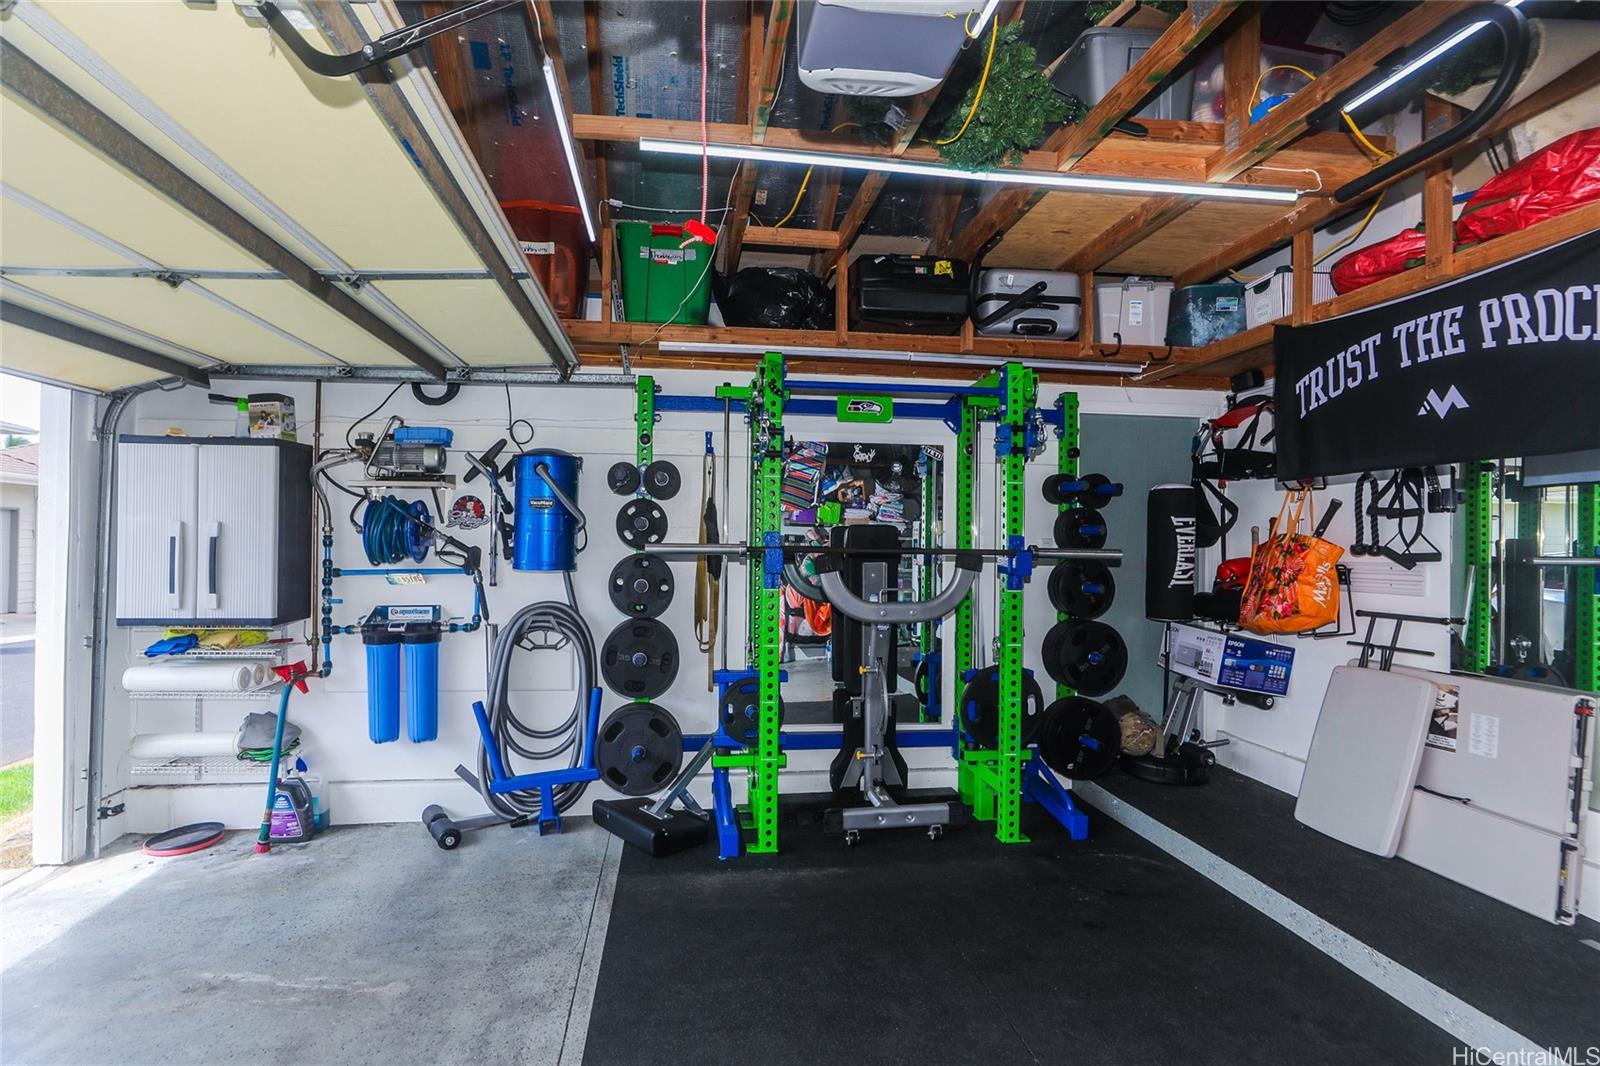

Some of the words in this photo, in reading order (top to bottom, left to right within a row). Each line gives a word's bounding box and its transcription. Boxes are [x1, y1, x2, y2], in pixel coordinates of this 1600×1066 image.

[612, 55, 625, 117] TechShield
[1295, 333, 1382, 420] TRUST
[1392, 305, 1466, 368] THE
[926, 448, 942, 459] YETI
[1168, 516, 1196, 588] EVERLAST
[1228, 640, 1245, 648] EPSON
